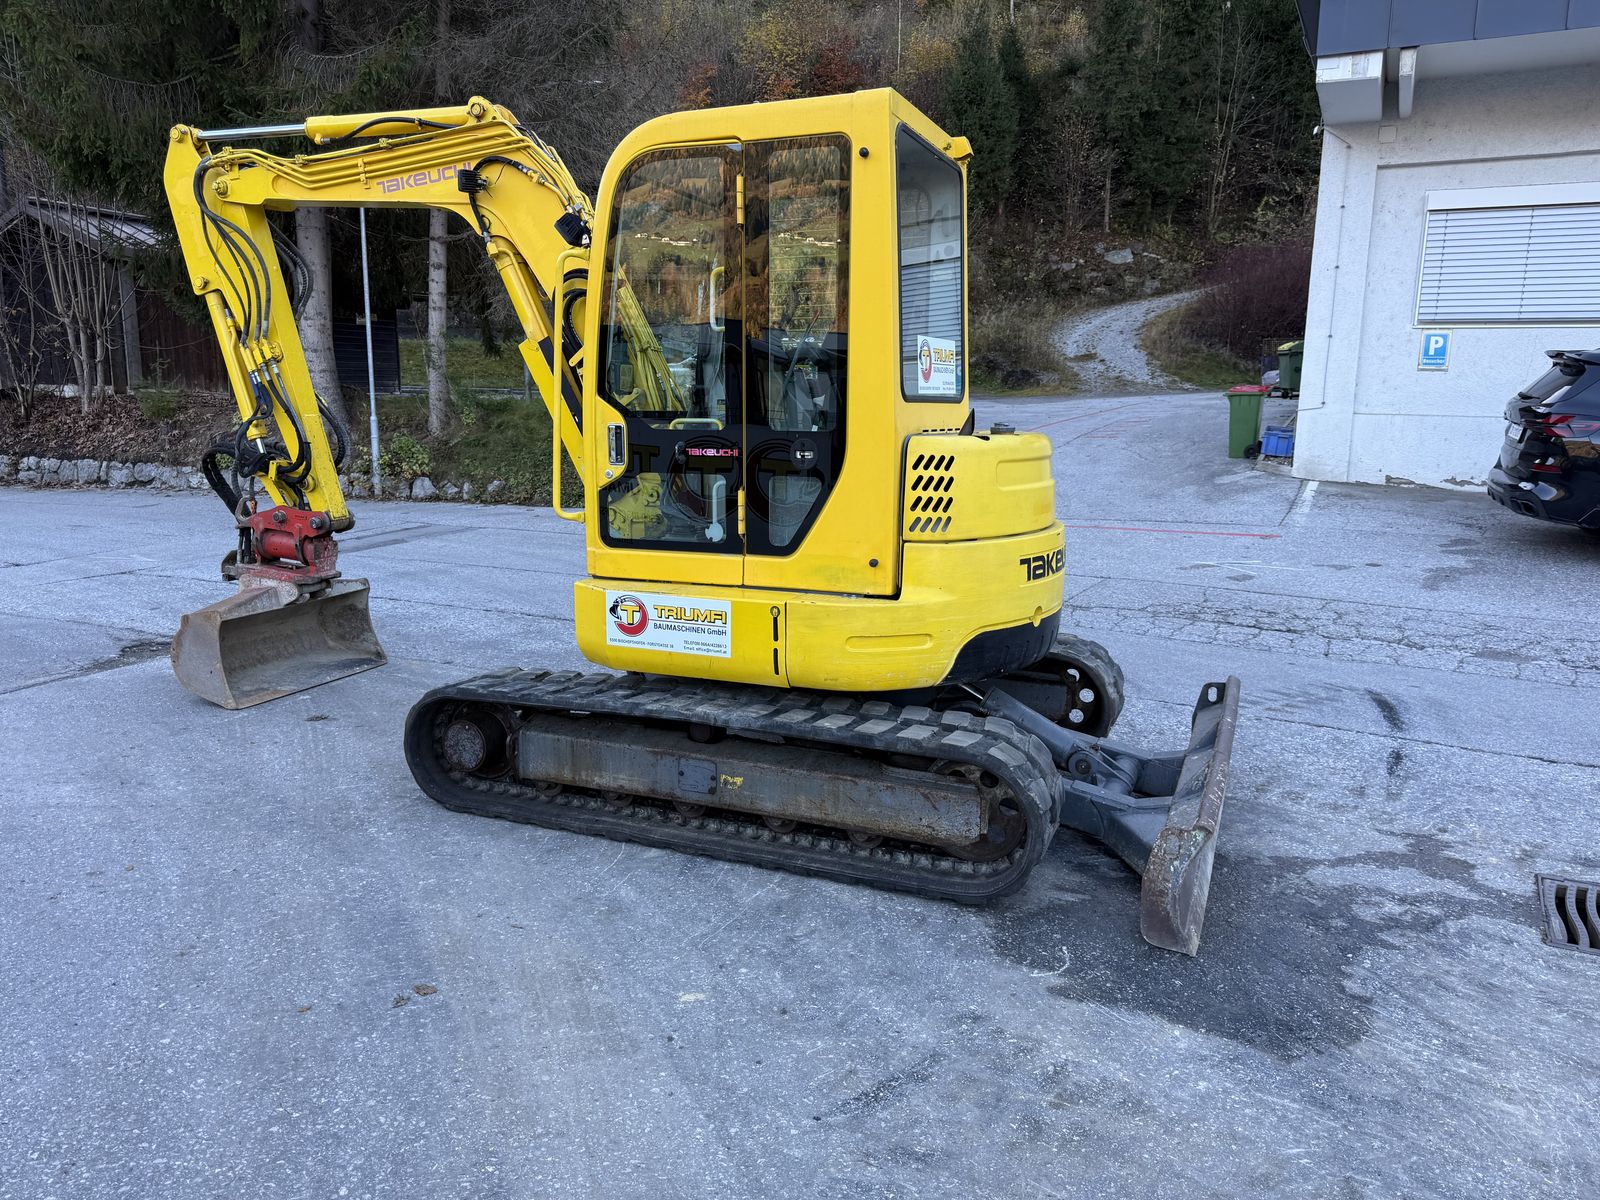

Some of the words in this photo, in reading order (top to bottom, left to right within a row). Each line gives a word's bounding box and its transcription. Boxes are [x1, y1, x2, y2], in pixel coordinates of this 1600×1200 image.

[1428, 335, 1444, 355] P
[685, 448, 739, 457] TAKEUCHI
[1020, 547, 1064, 582] TAKE
[653, 604, 727, 624] TRIUMFI
[653, 622, 706, 634] BAUMASCHINEN
[707, 627, 727, 636] GmbH
